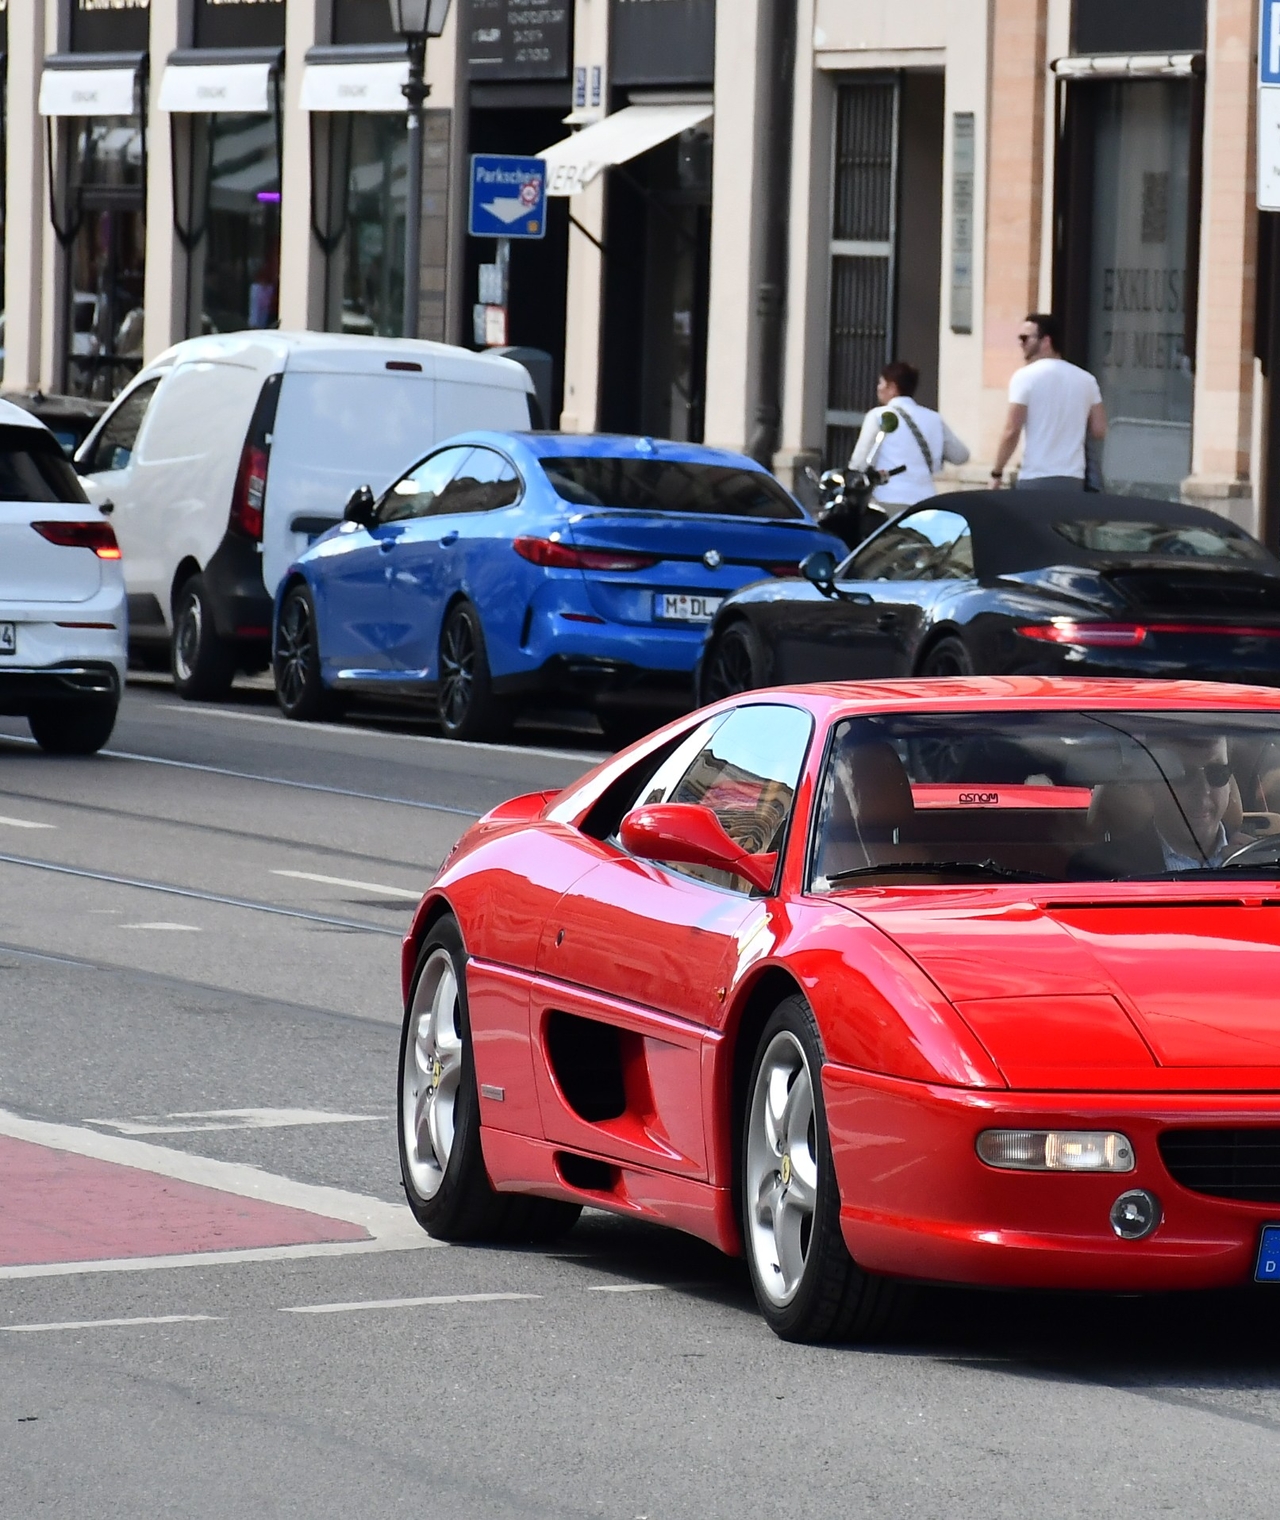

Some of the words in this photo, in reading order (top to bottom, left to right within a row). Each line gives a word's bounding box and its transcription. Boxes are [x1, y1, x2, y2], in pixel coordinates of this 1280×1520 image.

[476, 165, 542, 185] Parkschein
[666, 597, 677, 614] M
[1265, 1260, 1277, 1274] D
